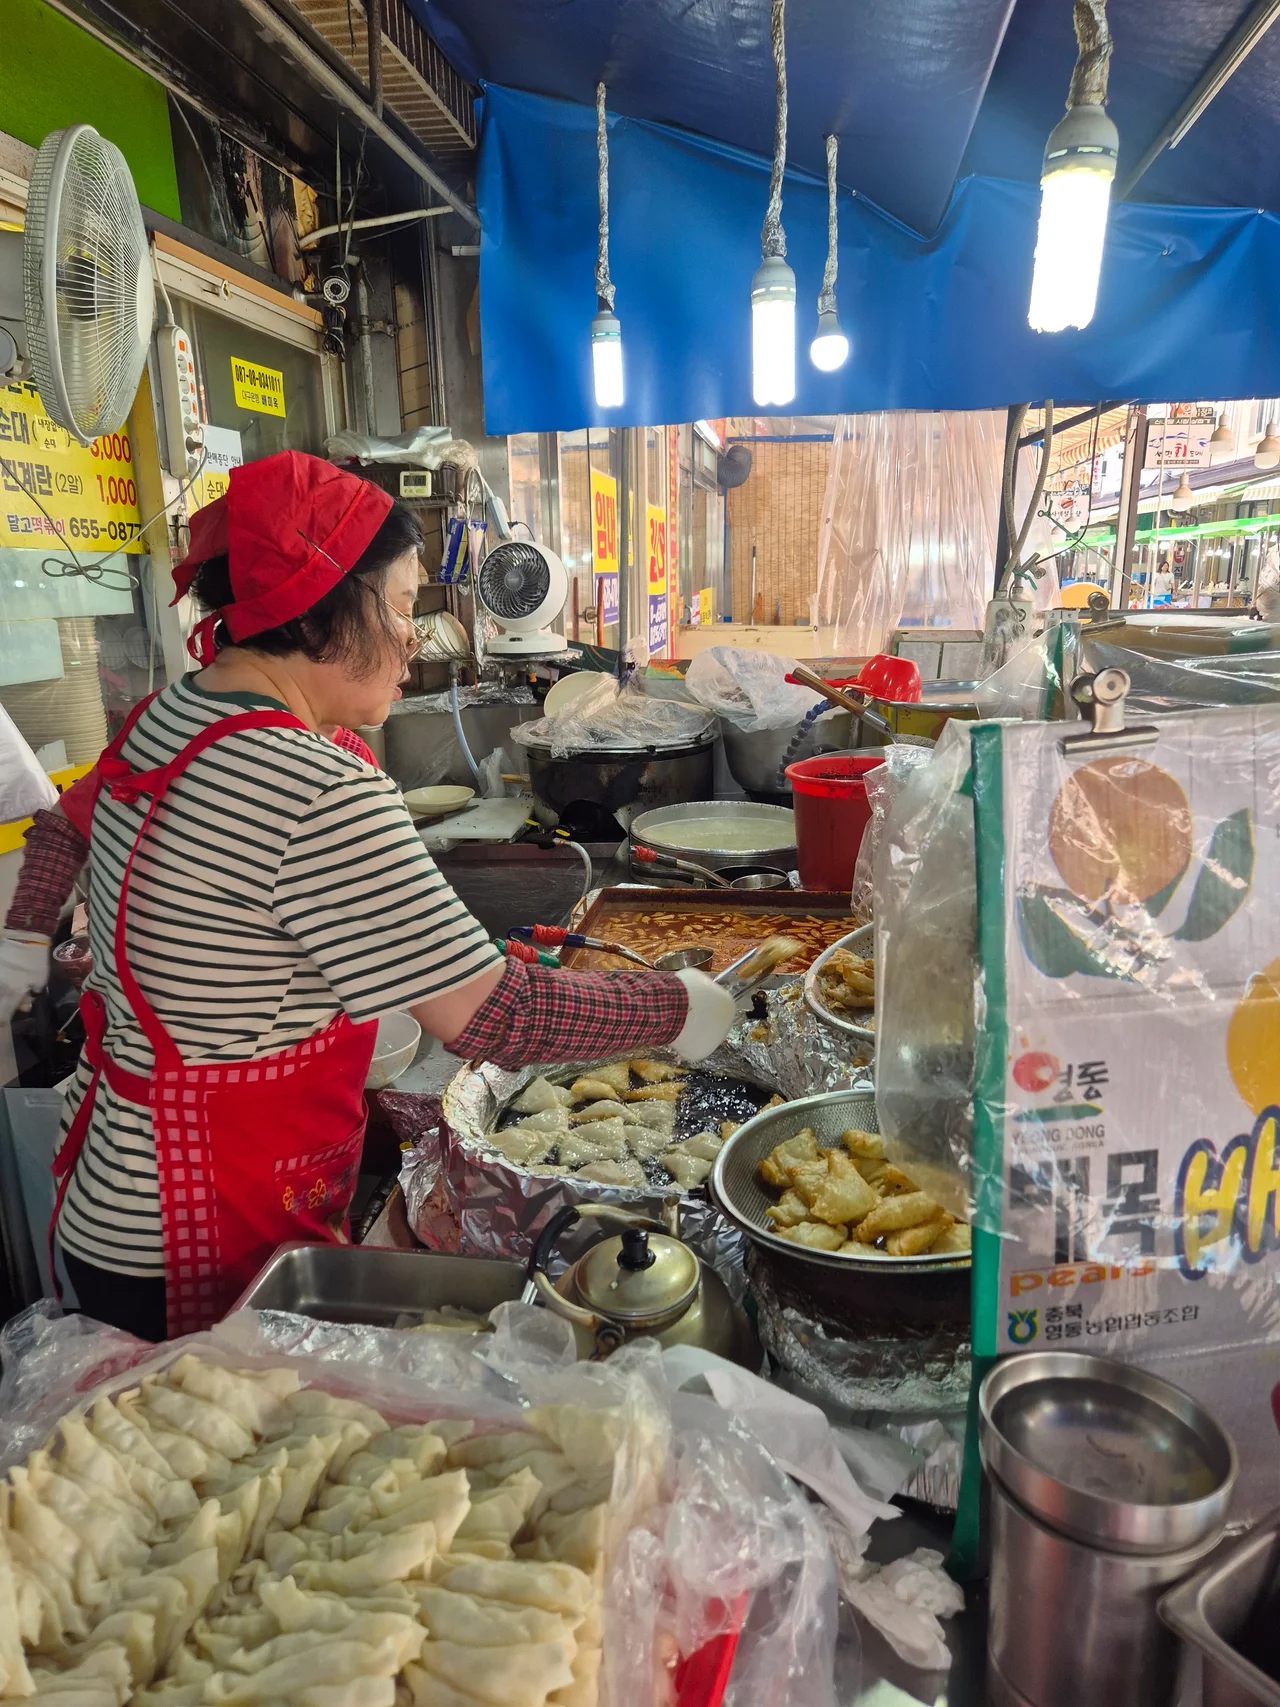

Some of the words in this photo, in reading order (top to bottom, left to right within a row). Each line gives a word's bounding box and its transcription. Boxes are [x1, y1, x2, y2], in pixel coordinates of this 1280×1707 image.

[0, 458, 53, 496] 찐계란
[55, 471, 84, 496] (2알)
[96, 474, 137, 506] 1,000
[6, 513, 66, 537] 달고떡볶이
[69, 516, 141, 542] 655-0877
[595, 491, 616, 560] 임대
[1065, 1123, 1105, 1141] DONG
[1045, 1303, 1084, 1323] 충북
